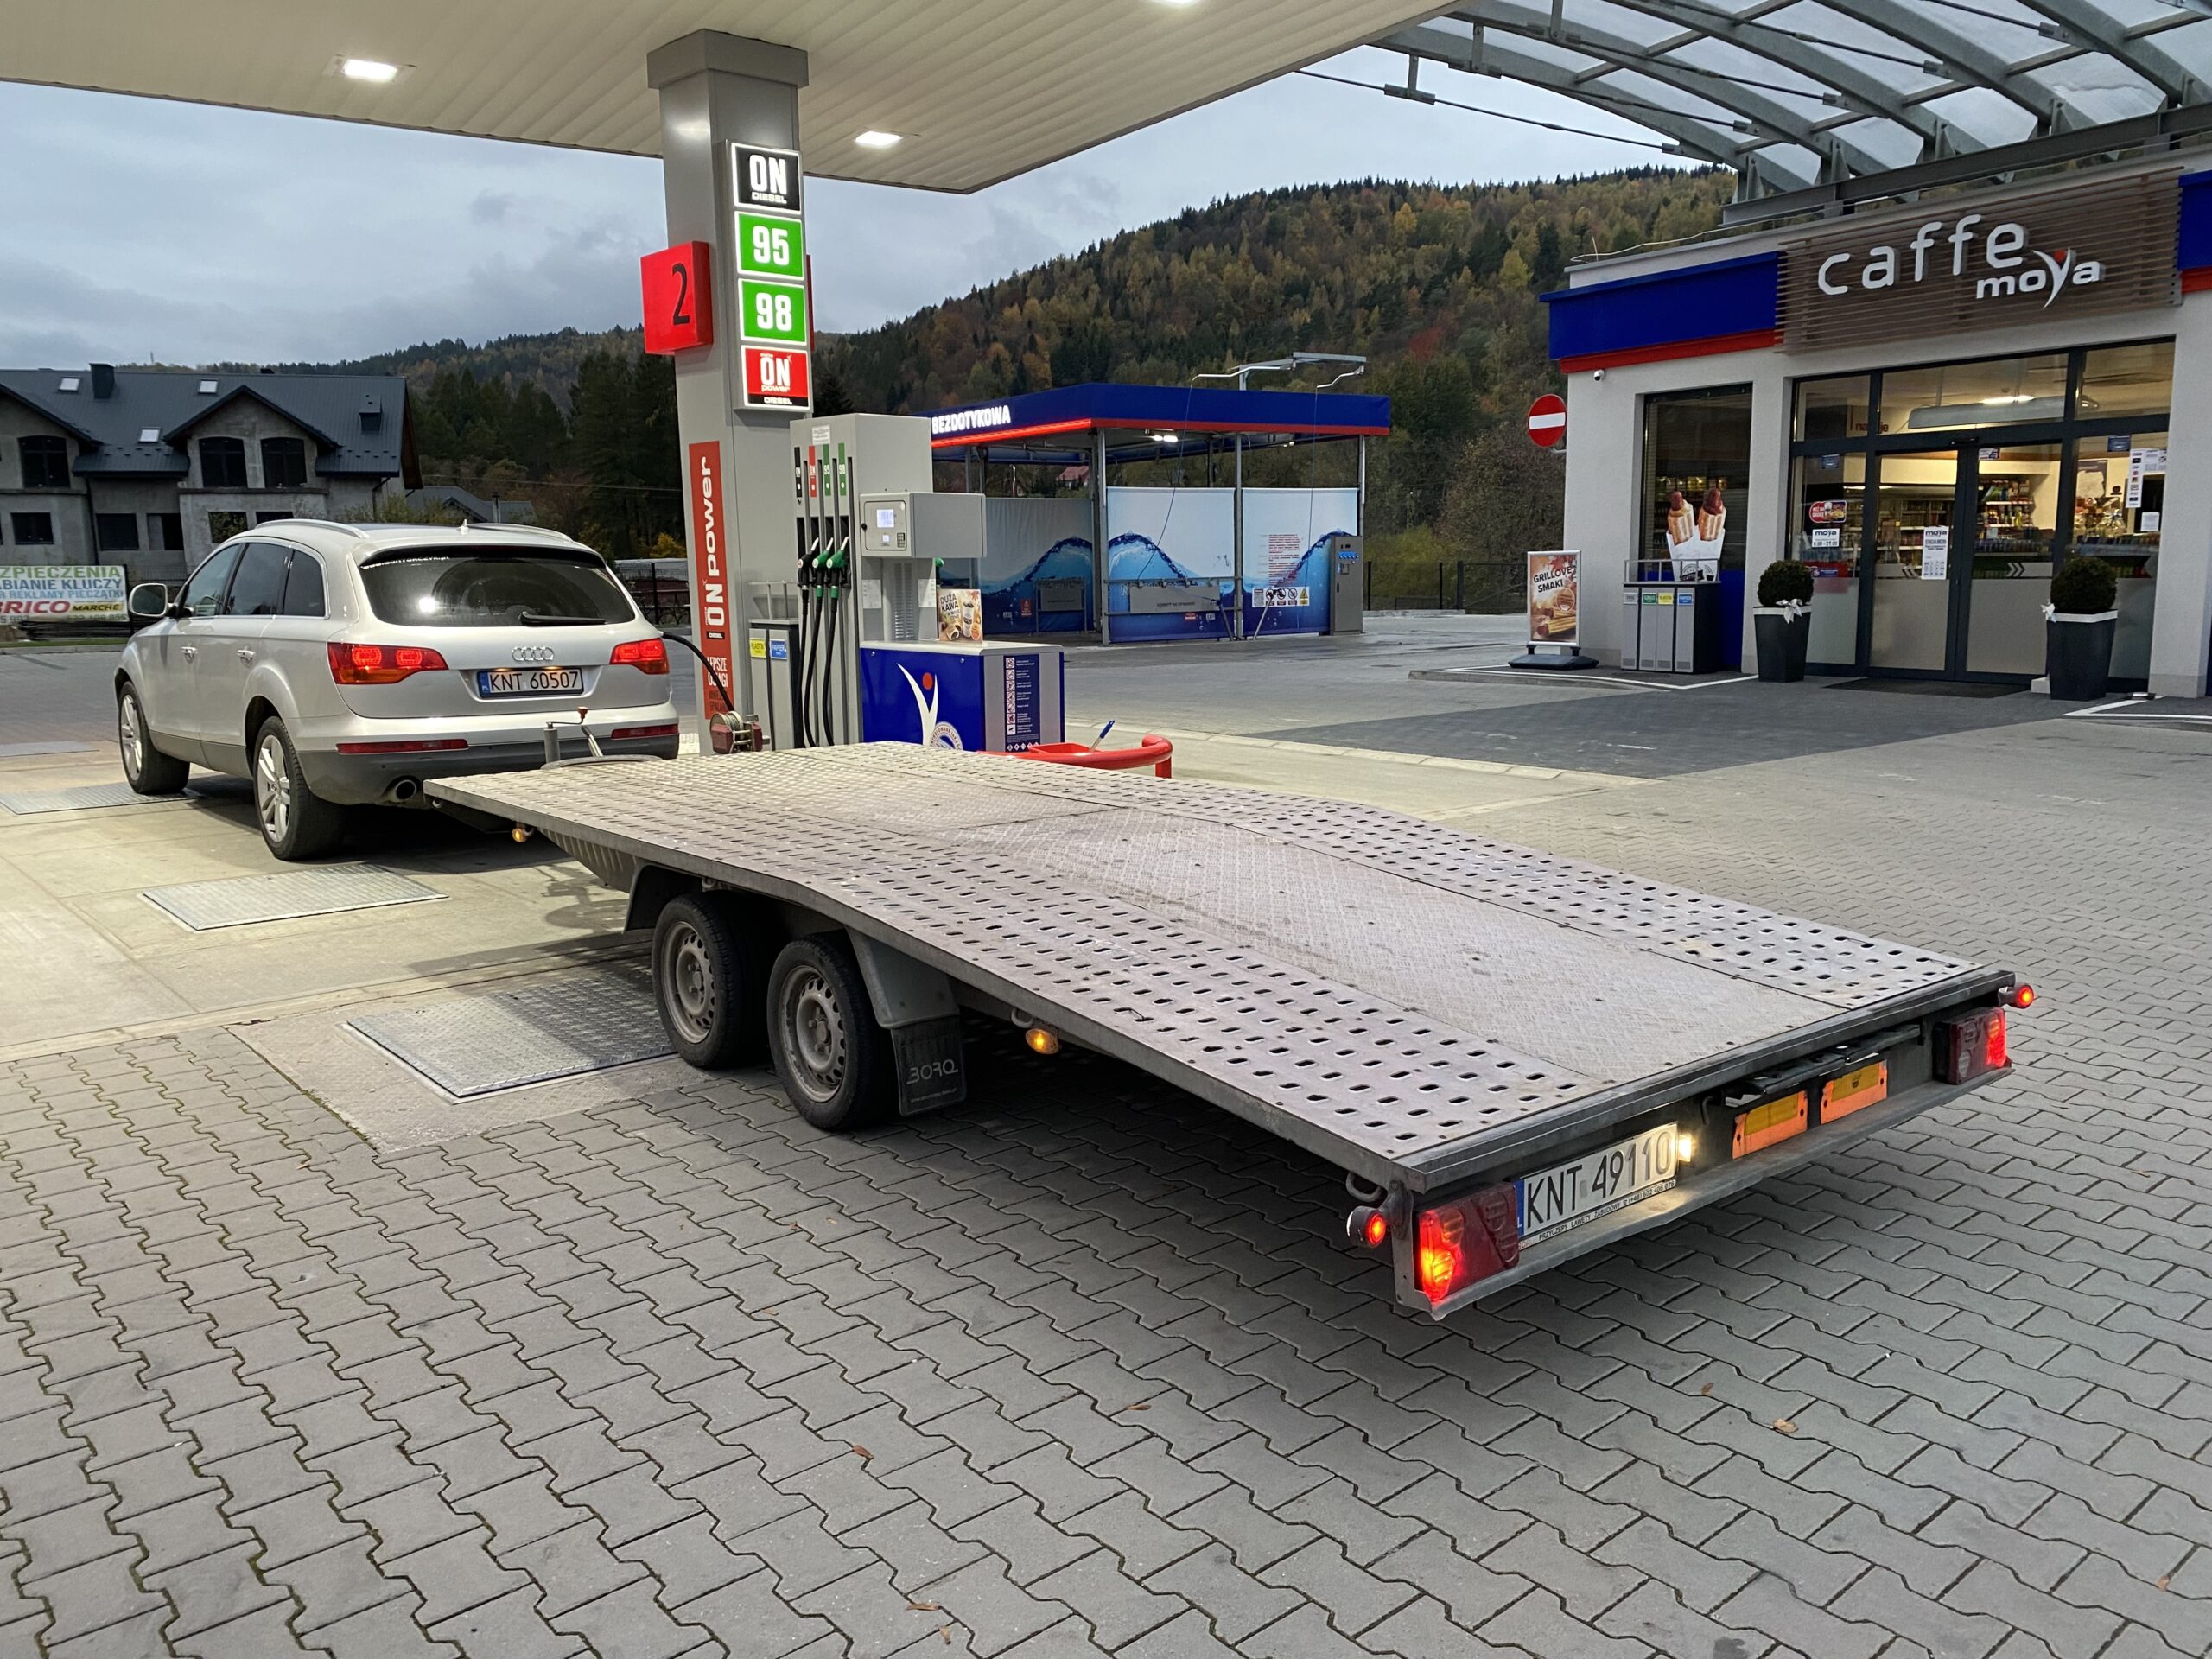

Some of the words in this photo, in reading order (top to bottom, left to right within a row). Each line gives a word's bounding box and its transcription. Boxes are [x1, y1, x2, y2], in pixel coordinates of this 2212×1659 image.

[749, 154, 787, 195] ON
[751, 191, 787, 204] DIESEL
[753, 226, 789, 266] 95
[1818, 213, 2026, 296] caffe
[1976, 247, 2102, 309] moya
[672, 263, 690, 325] 2
[756, 292, 792, 331] 98
[760, 355, 791, 387] ON
[931, 404, 1011, 434] BEZDOTYKOWA
[702, 456, 720, 576] power
[0, 579, 57, 589] BIANIE
[61, 579, 121, 589] KLUCZY
[1534, 566, 1573, 583] GRILLOVE
[1538, 579, 1563, 593] SMAKI
[10, 590, 64, 600] REKLAMY
[941, 601, 959, 614] KAWA
[490, 673, 522, 691] KNT
[530, 671, 578, 689] 60507
[1528, 1164, 1583, 1229] KNT
[1592, 1131, 1670, 1199] 49110
[1539, 1224, 1568, 1240] PRZYCZEPY
[1571, 1215, 1592, 1228] LAWETY
